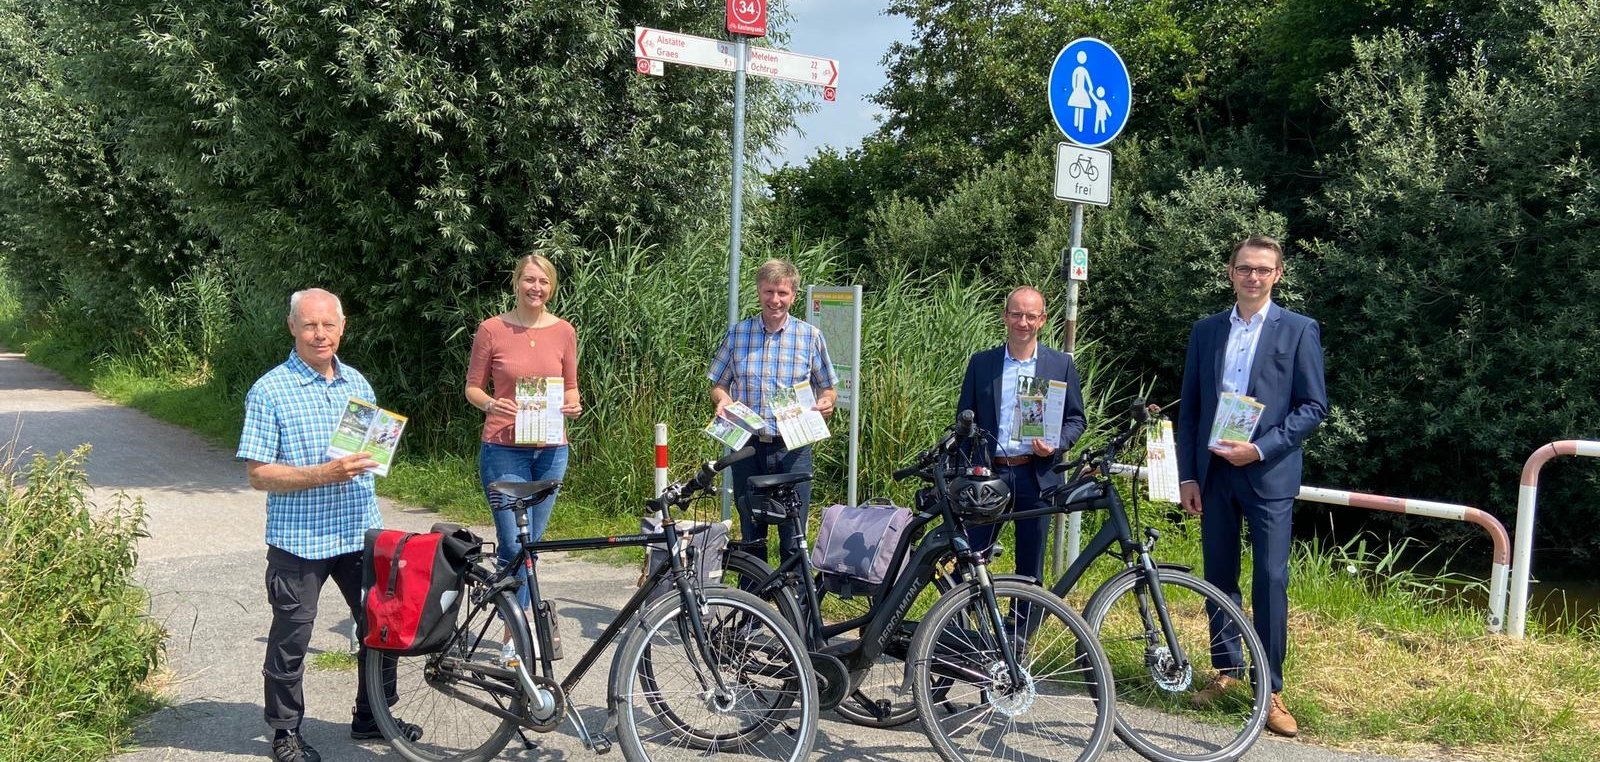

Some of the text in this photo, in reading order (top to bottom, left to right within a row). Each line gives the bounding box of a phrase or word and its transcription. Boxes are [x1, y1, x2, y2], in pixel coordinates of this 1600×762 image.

[739, 0, 755, 14] 34
[657, 35, 728, 54] Alstätte 20
[657, 48, 678, 58] Graes
[751, 51, 817, 69] Metelen 22
[751, 63, 778, 75] Ochtrup
[1075, 182, 1091, 195] frei
[877, 577, 920, 648] BERGAMONT
